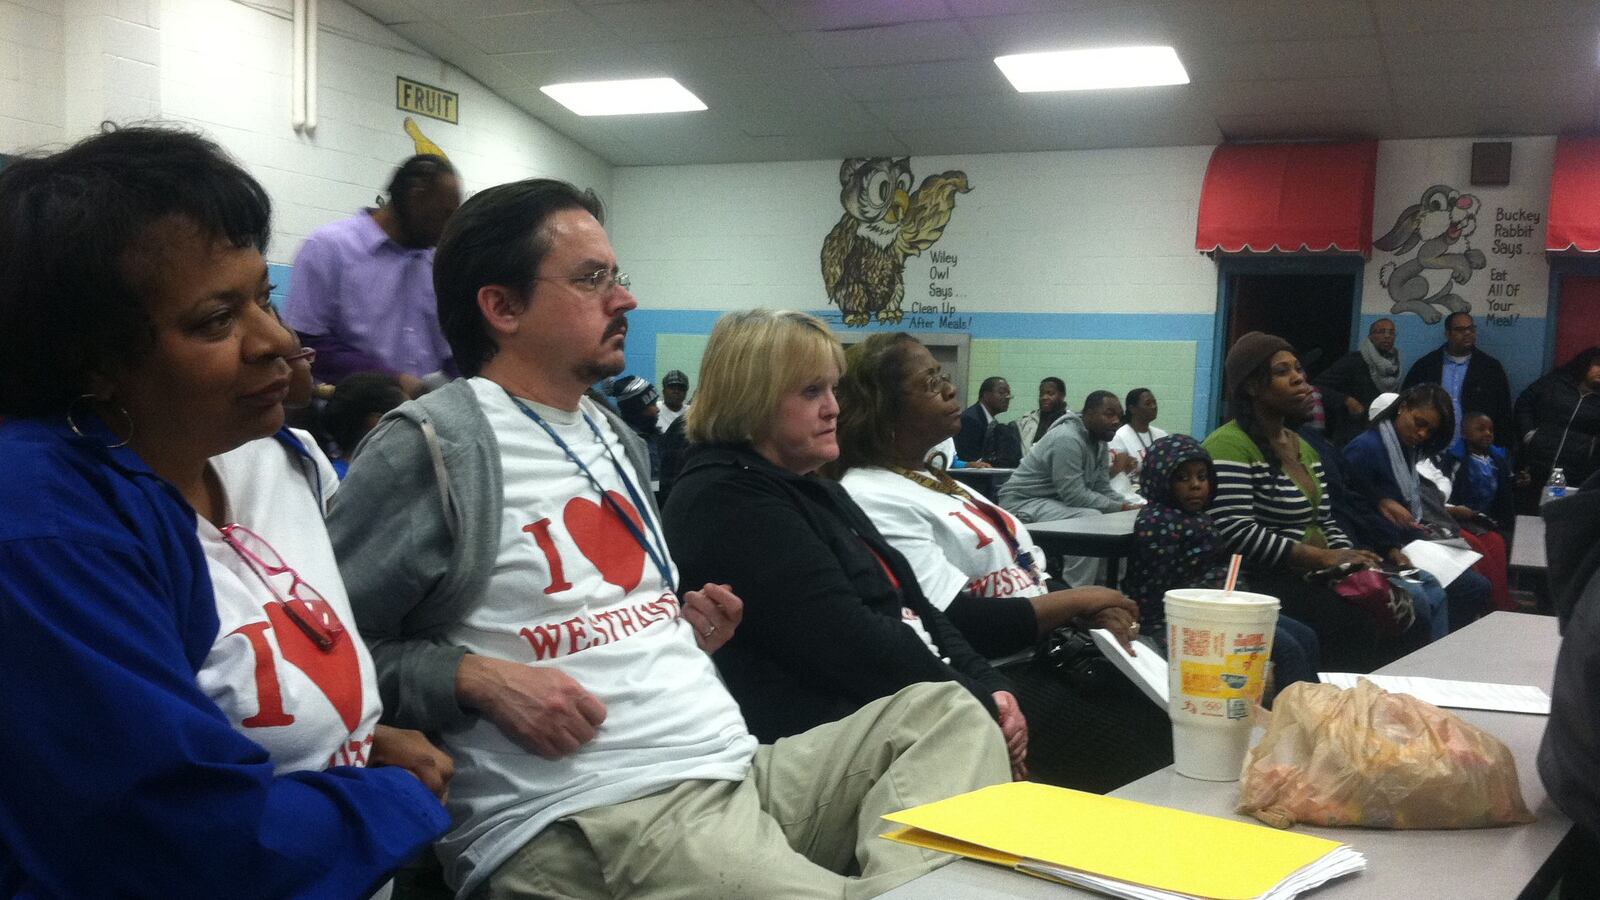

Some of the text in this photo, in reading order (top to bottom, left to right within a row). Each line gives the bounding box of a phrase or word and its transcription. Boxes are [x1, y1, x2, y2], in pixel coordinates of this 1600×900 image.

[403, 83, 453, 118] FRUIT
[1496, 207, 1540, 224] Buckey
[1494, 223, 1535, 238] Rabbit
[929, 250, 958, 267] Wiley
[929, 266, 949, 280] Owl
[1490, 268, 1508, 281] Eat
[1487, 284, 1520, 297] All Of
[911, 301, 956, 317] Clean Up
[1486, 299, 1513, 312] Your
[908, 316, 973, 330] After Meals!
[1486, 313, 1520, 327] Meal!
[522, 517, 573, 595] I
[223, 621, 295, 729] I
